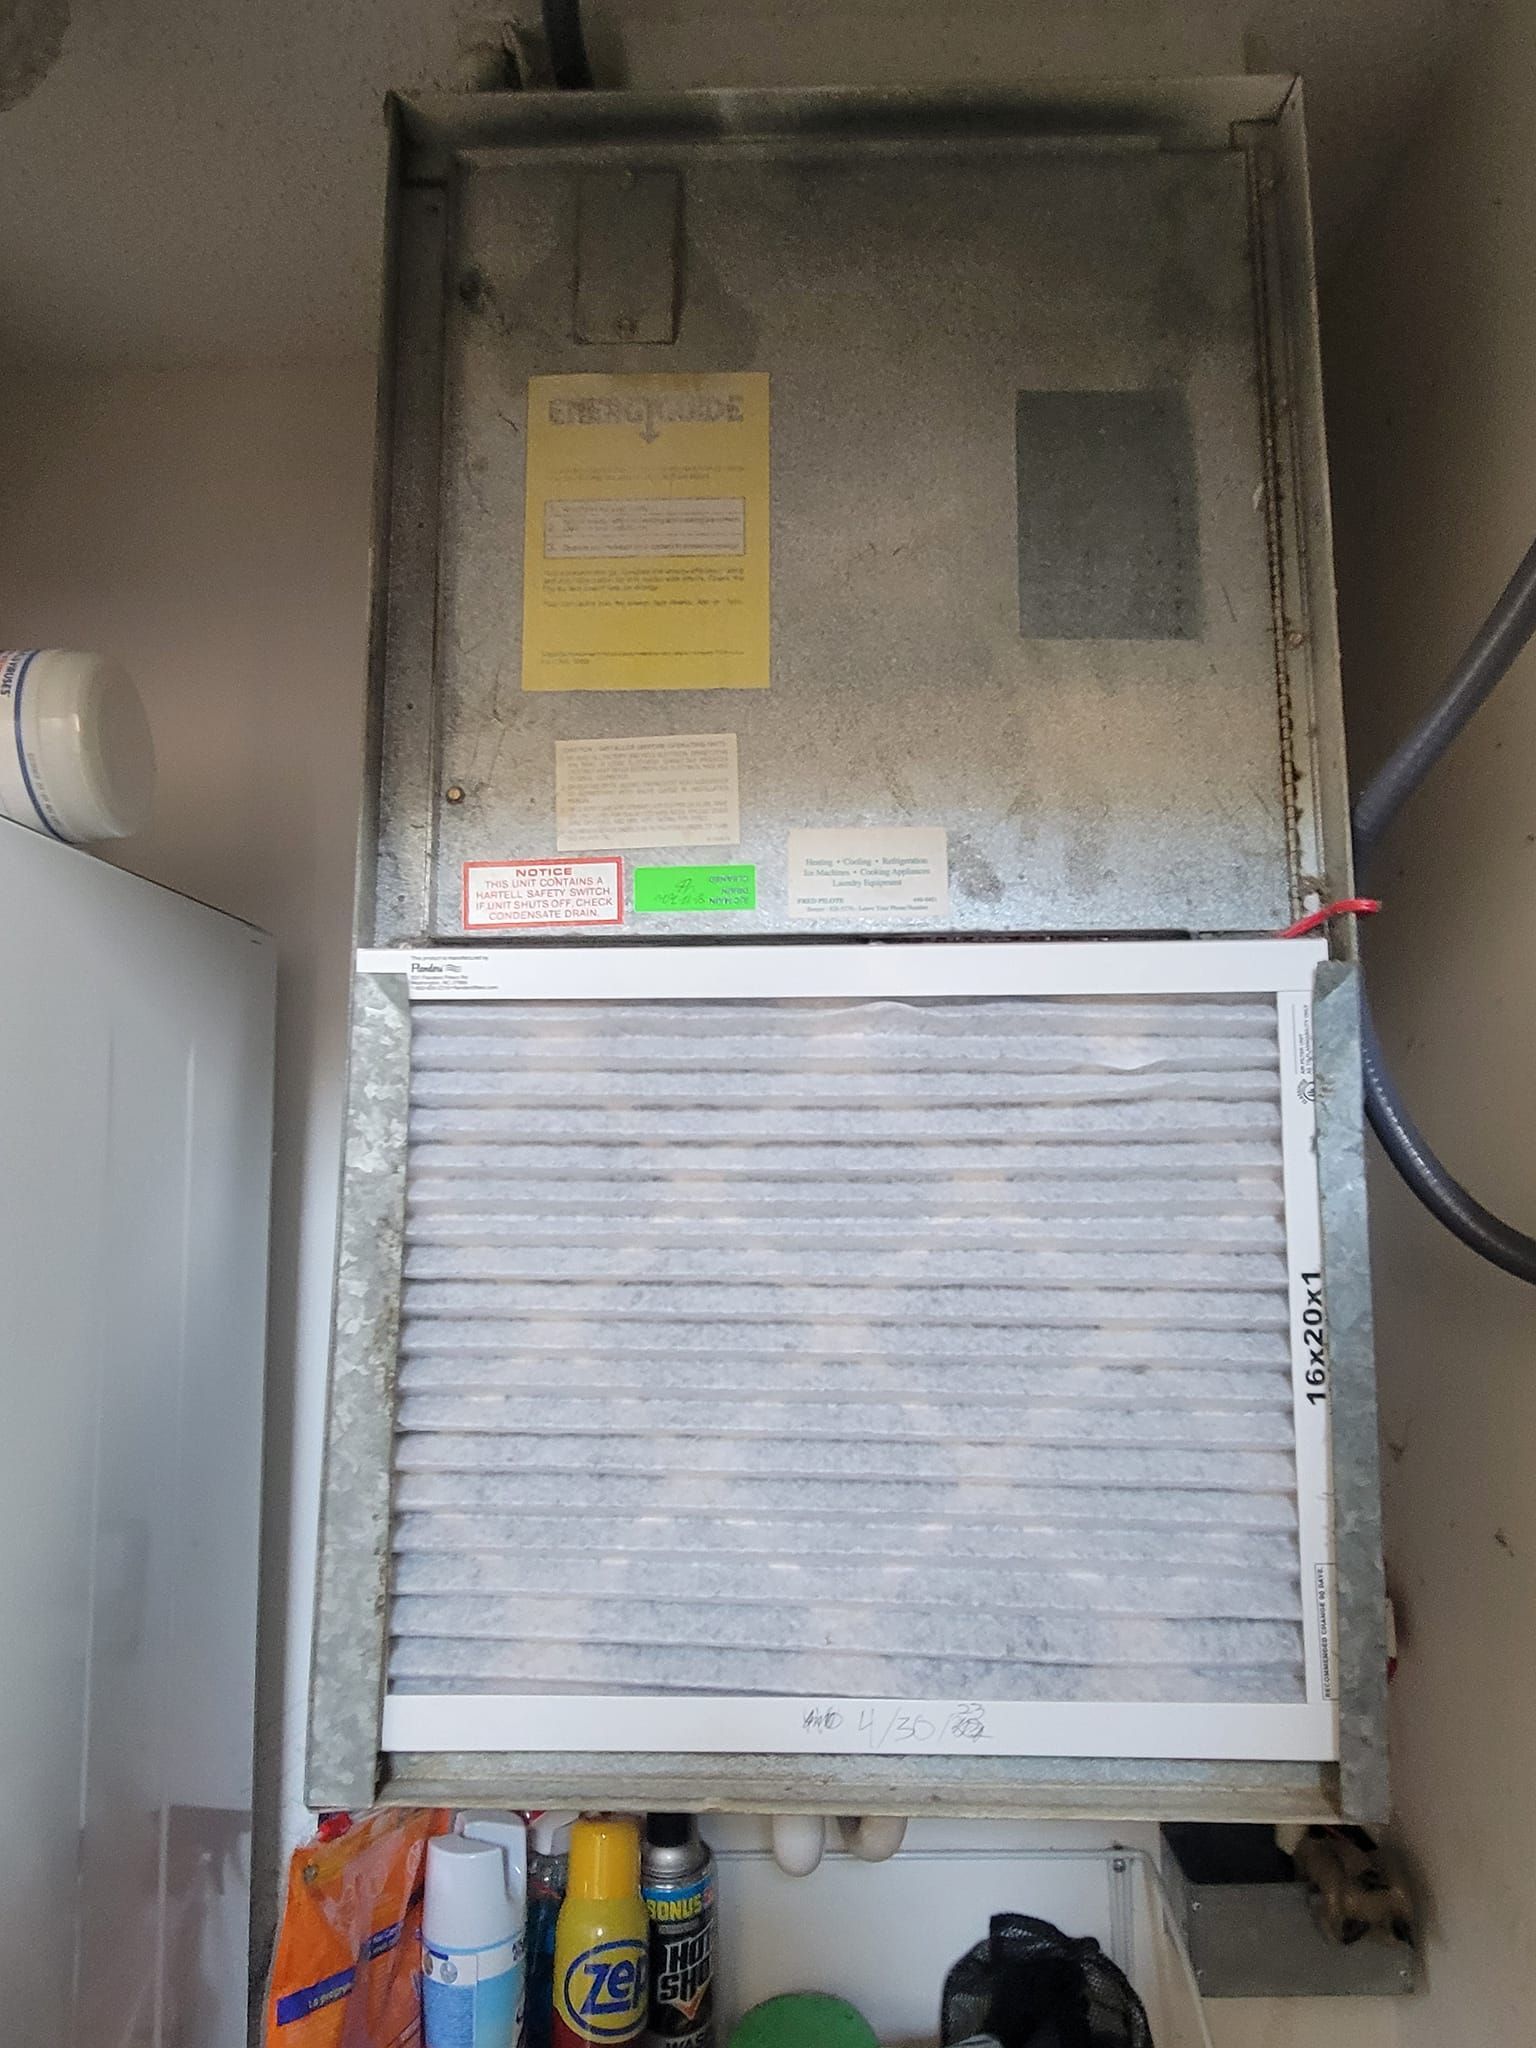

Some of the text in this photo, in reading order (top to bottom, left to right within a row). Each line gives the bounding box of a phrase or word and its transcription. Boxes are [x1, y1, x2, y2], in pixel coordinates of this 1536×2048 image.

[515, 867, 572, 877] NOTICE
[485, 876, 603, 889] THIS UNIT CONTAINS A
[476, 886, 611, 900] HARTELL SAFETY SWITCH
[476, 901, 485, 910] IF
[487, 900, 511, 910] UNIT
[513, 899, 549, 909] SHUTS
[575, 897, 613, 907] CHECK
[489, 909, 561, 920] CONDENSATE
[1301, 1273, 1326, 1405] 16x20x1
[1318, 1602, 1327, 1635] CHANGE
[1321, 1637, 1331, 1698] RECOMMENDED
